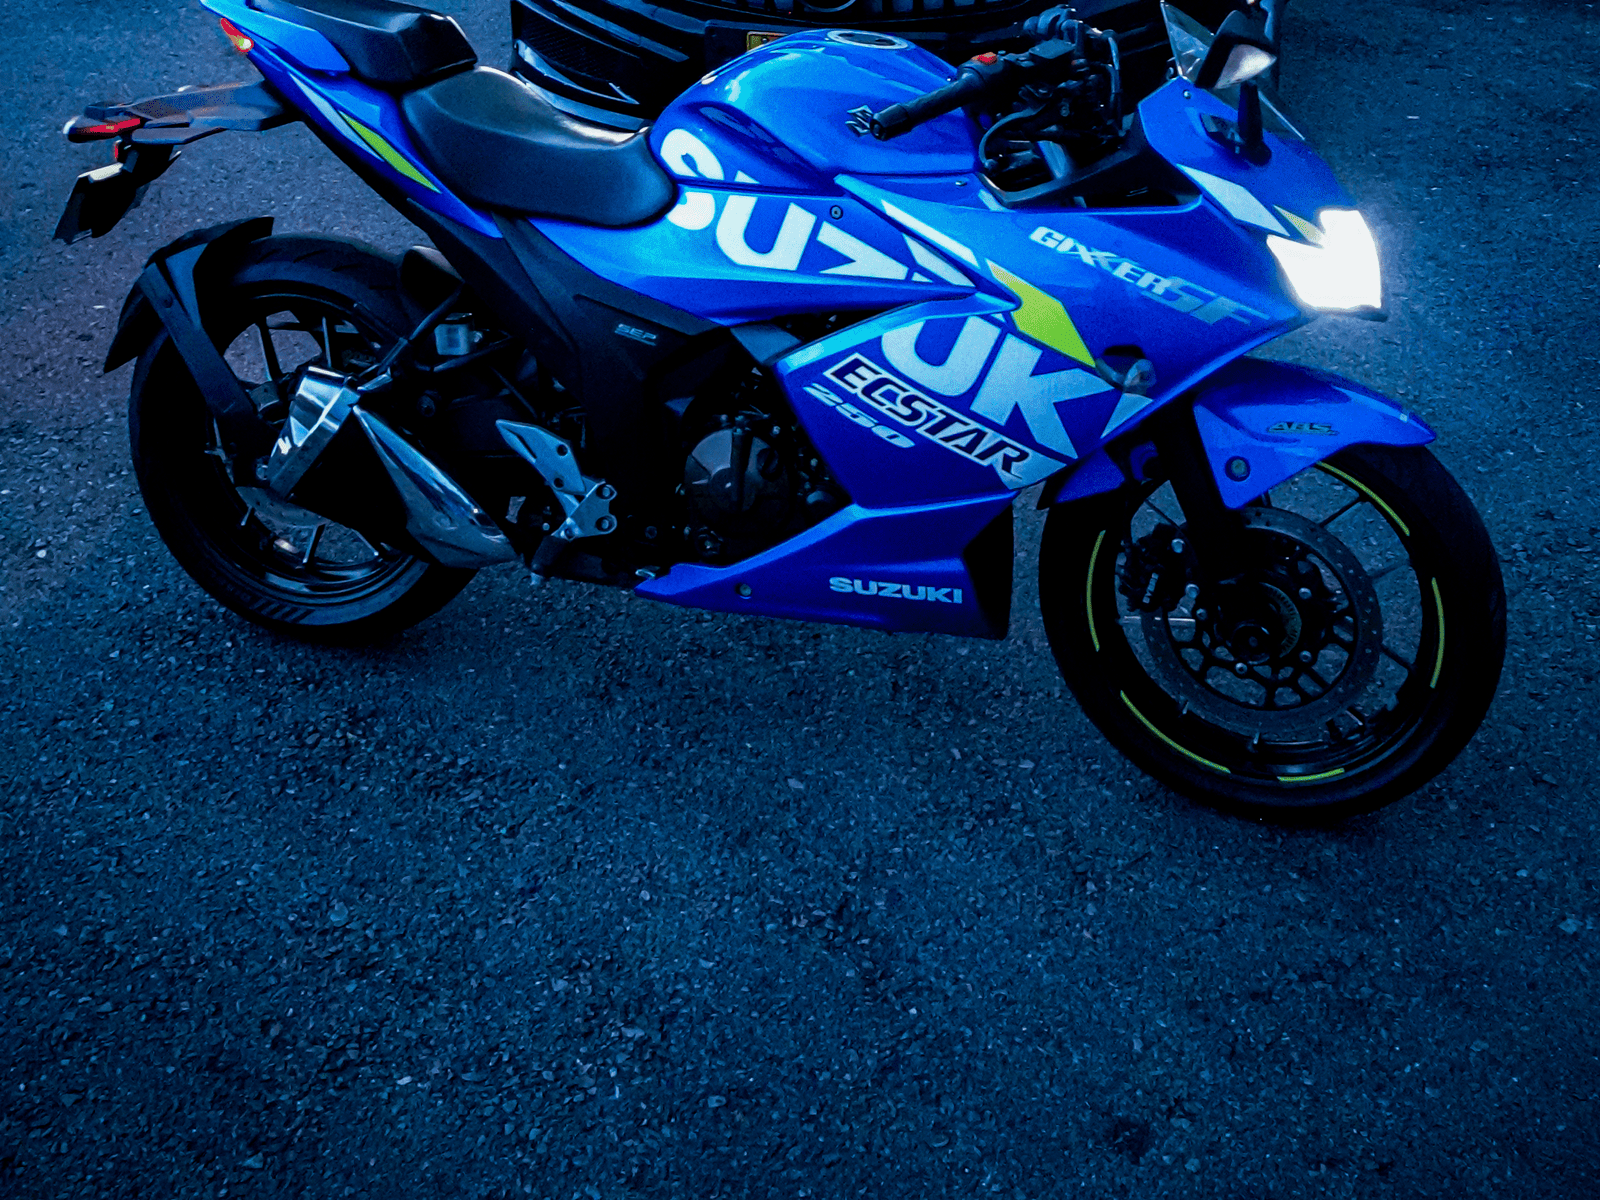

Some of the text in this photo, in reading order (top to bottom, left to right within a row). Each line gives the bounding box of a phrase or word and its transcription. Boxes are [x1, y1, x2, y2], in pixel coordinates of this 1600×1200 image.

[1028, 225, 1174, 296] GIXXER
[803, 382, 916, 449] 250
[823, 353, 1028, 480] ECSTAR
[1266, 420, 1333, 436] ABS
[828, 576, 964, 604] SUZUKI
